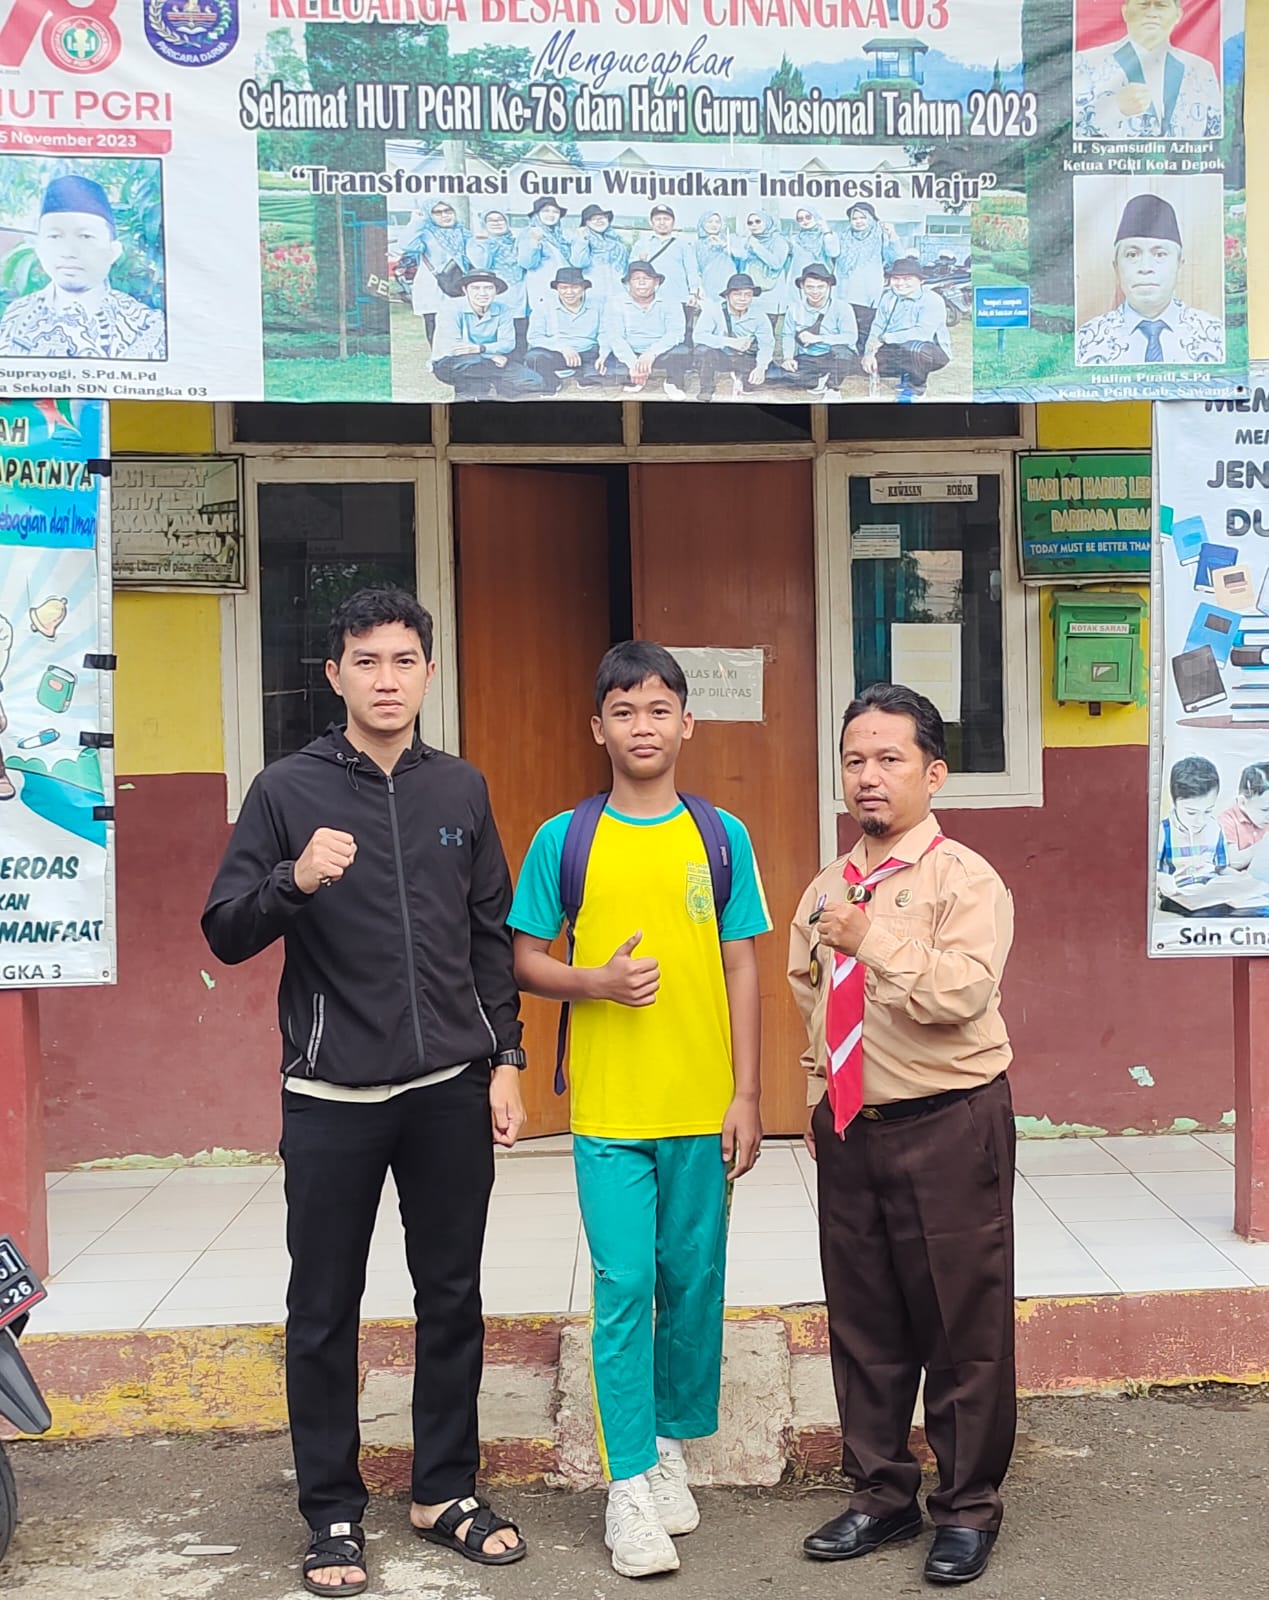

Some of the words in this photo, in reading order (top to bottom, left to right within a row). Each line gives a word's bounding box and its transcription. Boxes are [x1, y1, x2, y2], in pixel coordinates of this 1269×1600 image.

[270, 0, 468, 23] KELUARGA
[482, 0, 601, 24] BESAR
[615, 0, 688, 25] SDN
[702, 0, 889, 29] CINANGKA
[901, 0, 949, 30] 03
[533, 29, 735, 93] Mengucapkan
[0, 88, 64, 120] UT
[75, 90, 173, 122] PGRI
[240, 79, 349, 130] Selamat
[356, 83, 410, 131] HUT
[417, 84, 482, 131] PGRI
[489, 85, 568, 133] Ke-78
[575, 86, 623, 133] dan
[630, 85, 688, 133] Hari
[693, 87, 758, 135] Guru
[766, 88, 875, 136] Nasional
[882, 92, 960, 137] Tahun
[968, 92, 1038, 138] 2023
[11, 131, 94, 148] November
[97, 133, 137, 147] 2023
[1072, 142, 1087, 154] H.
[1091, 142, 1166, 155] Syamsudin
[1170, 142, 1214, 154] Azhari
[1063, 158, 1104, 172] Ketua
[1108, 158, 1141, 172] PGRI
[1146, 158, 1178, 171] Kota
[1181, 157, 1225, 174] Depok
[519, 170, 592, 195] Guru
[602, 169, 748, 201] Wujudkan
[759, 172, 901, 198] Indonesia
[82, 370, 157, 381] S.Pd.M.Pd
[1091, 372, 1131, 385] Halim
[13, 383, 72, 393] Sekolah
[77, 384, 108, 394] SDN
[113, 384, 183, 397] Cinangka
[187, 387, 208, 397] 03
[1058, 388, 1099, 399] Ketua
[1104, 388, 1139, 398] PGRI
[888, 486, 922, 497] KAWASAN
[946, 484, 973, 496] ROKOK
[1027, 478, 1060, 502] HARI
[1061, 477, 1081, 500] INI
[1083, 476, 1128, 500] HARUS
[1051, 508, 1117, 532] DARIPADA
[1030, 544, 1058, 555] TODAY
[1061, 542, 1083, 553] MUST
[1086, 542, 1096, 552] BE
[1098, 542, 1128, 552] BETTER
[1072, 624, 1098, 633] KOTAK
[1100, 624, 1127, 633] SARAN
[1179, 926, 1223, 946] Sdn
[2, 964, 45, 980] GKA
[51, 963, 62, 979] 3
